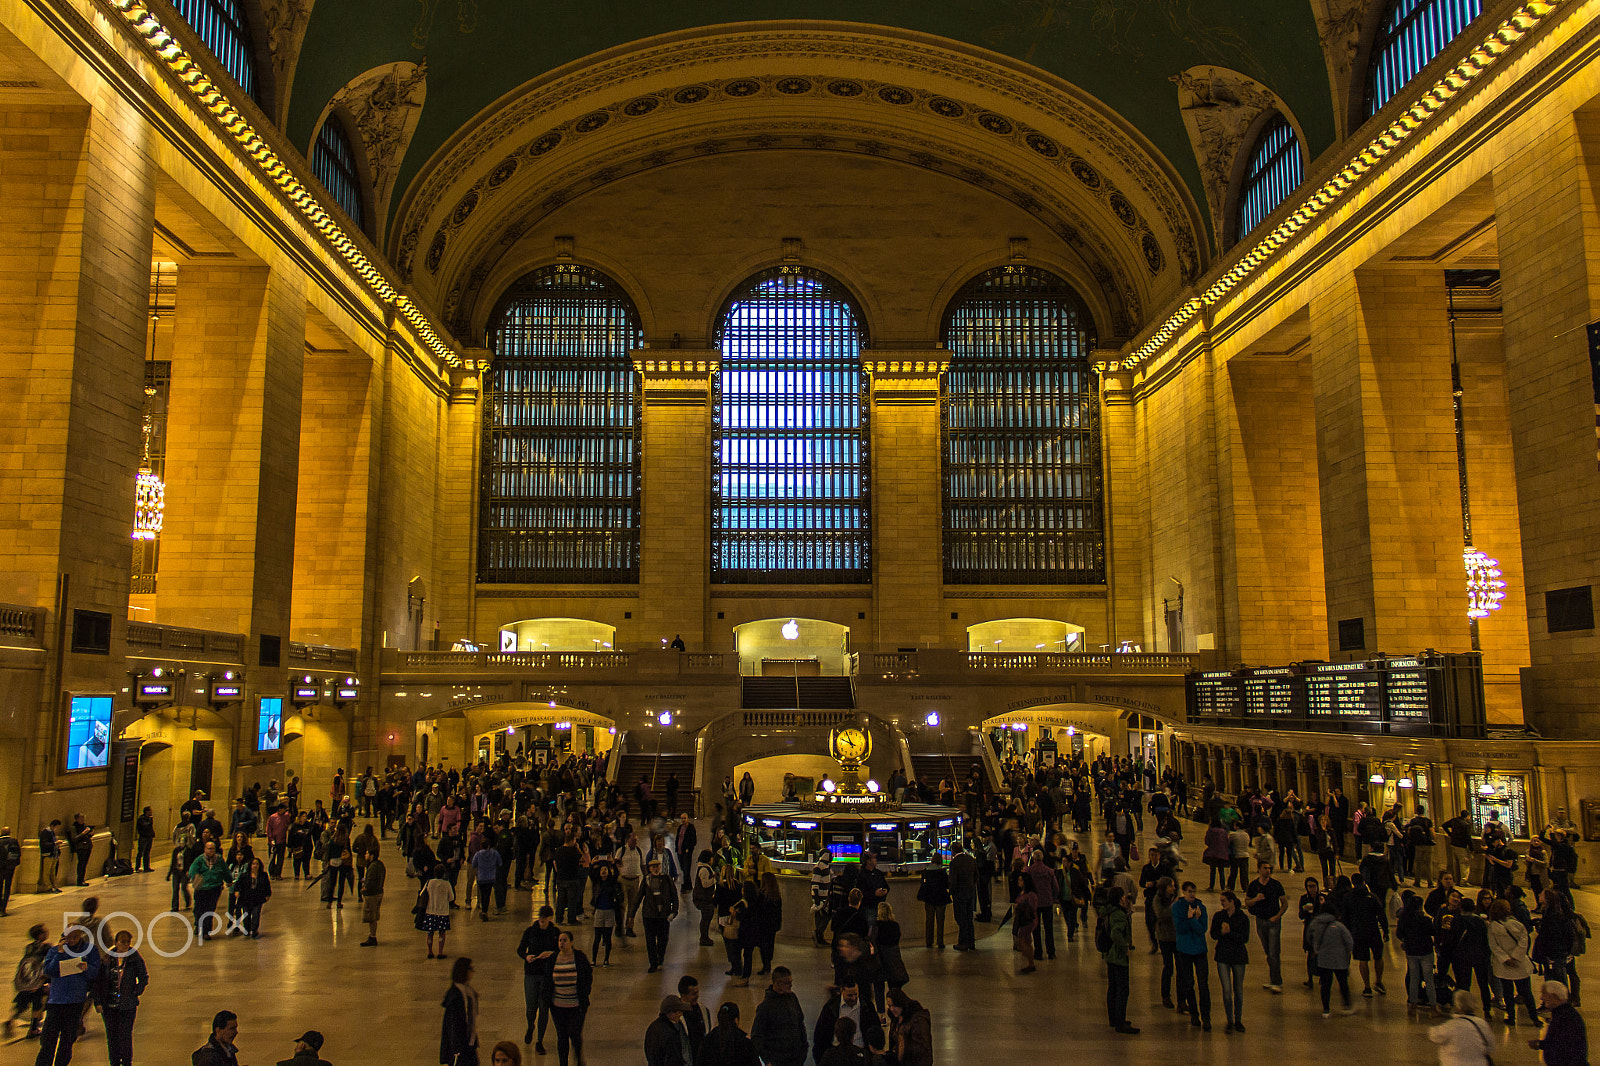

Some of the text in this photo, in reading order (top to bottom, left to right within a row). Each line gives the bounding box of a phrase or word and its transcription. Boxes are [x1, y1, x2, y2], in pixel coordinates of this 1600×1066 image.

[1007, 696, 1051, 710] LEXINGTON
[1094, 694, 1161, 711] TICKET MACHINES
[506, 717, 529, 725] STREET
[1037, 716, 1065, 724] SUBWAY
[840, 795, 876, 804] Information
